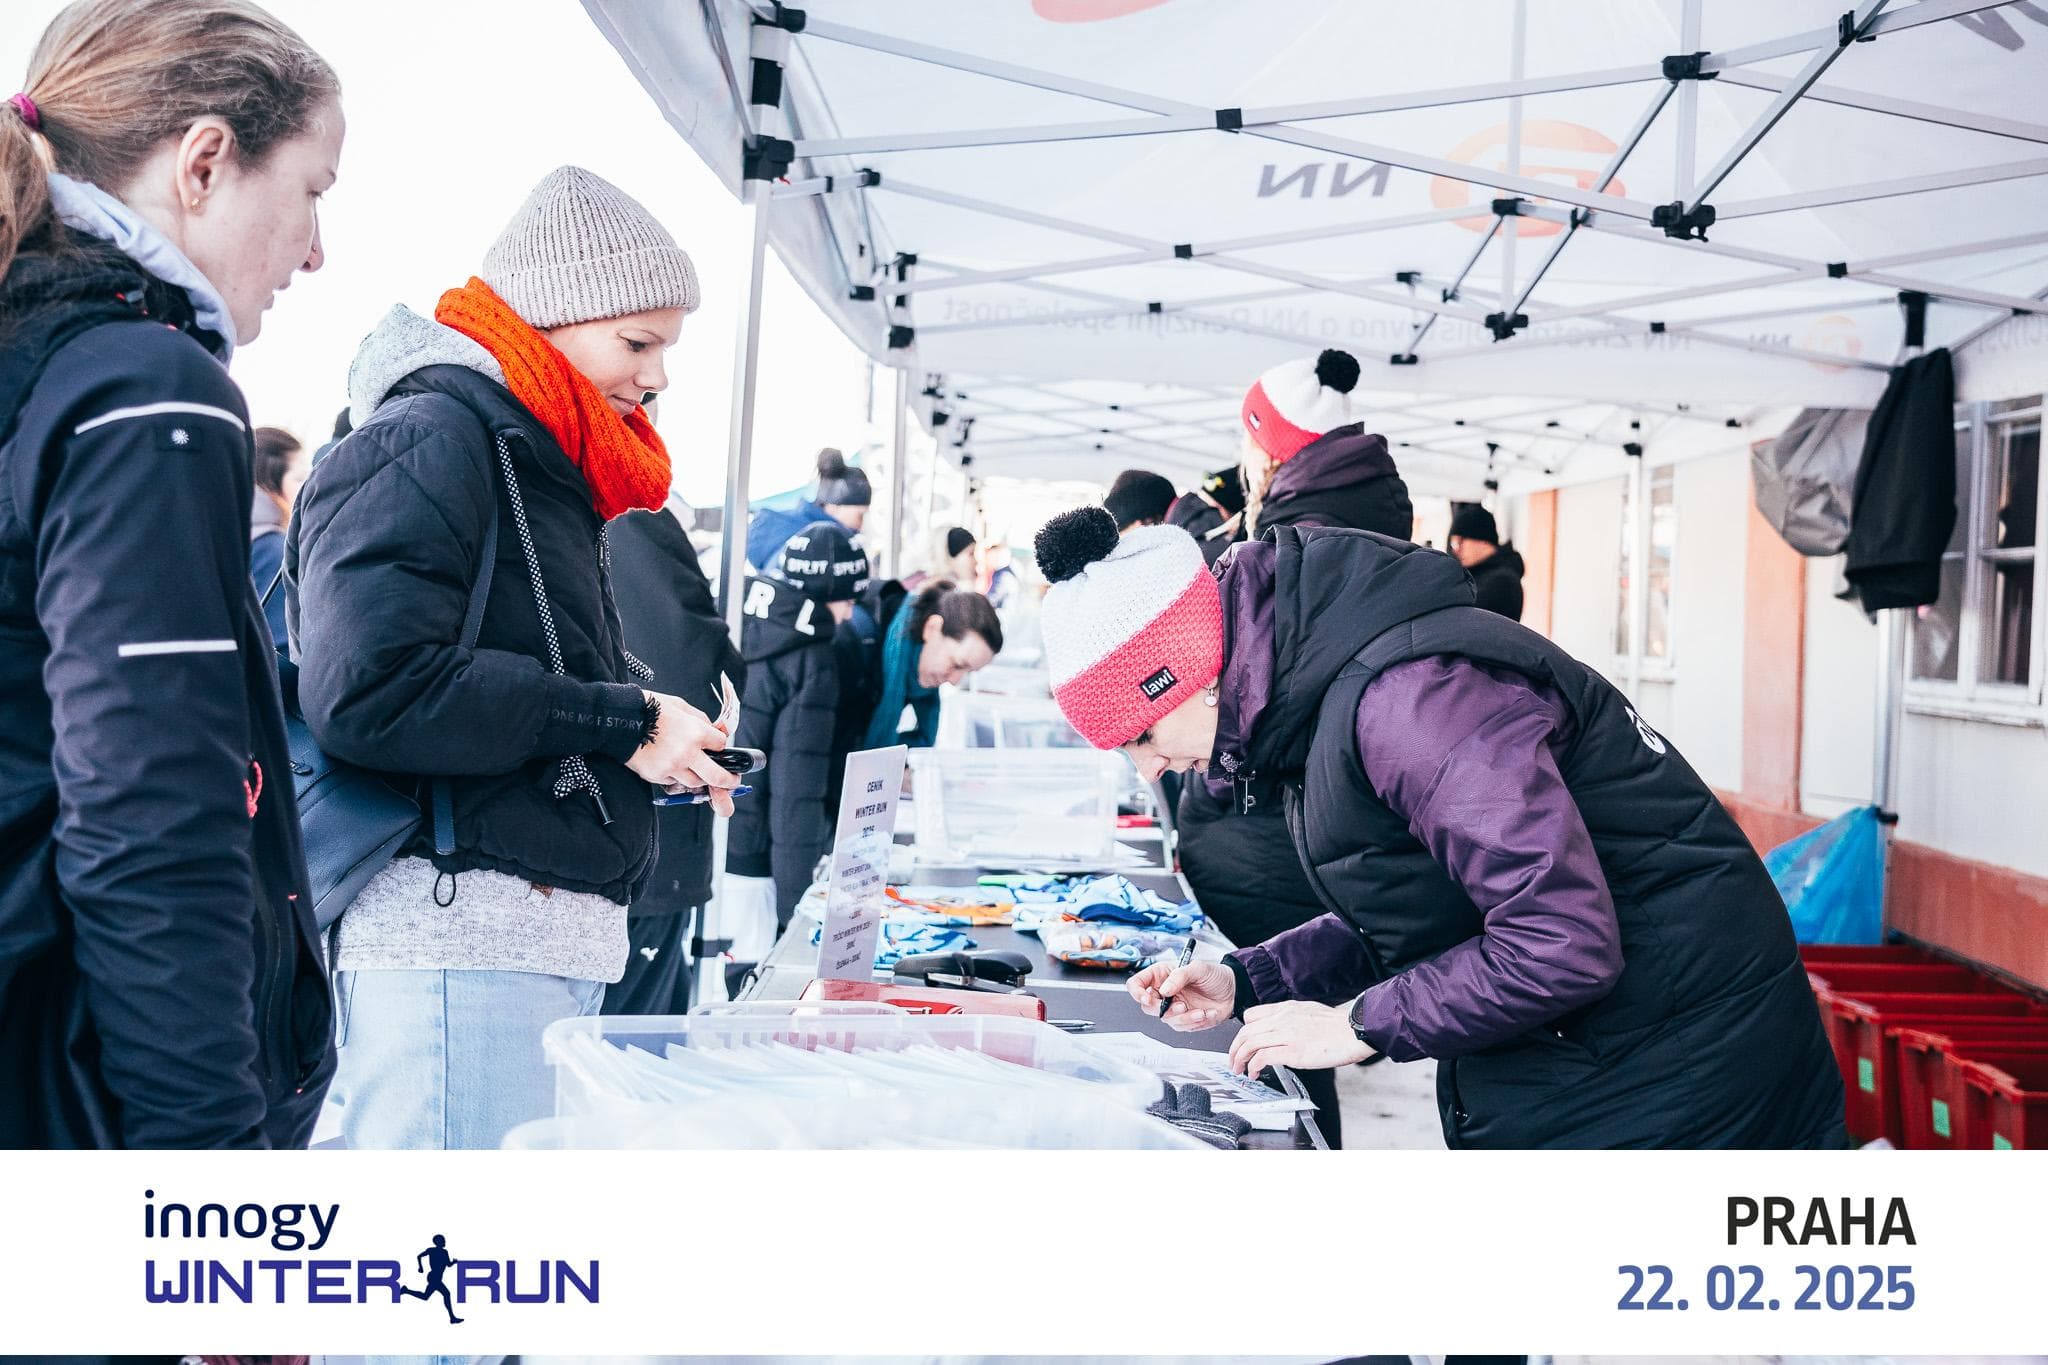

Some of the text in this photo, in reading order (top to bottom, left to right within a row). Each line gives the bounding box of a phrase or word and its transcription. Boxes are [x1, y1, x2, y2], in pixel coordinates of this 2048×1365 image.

[1142, 669, 1174, 695] lawi
[606, 717, 643, 730] STORY
[855, 804, 876, 819] WINTER
